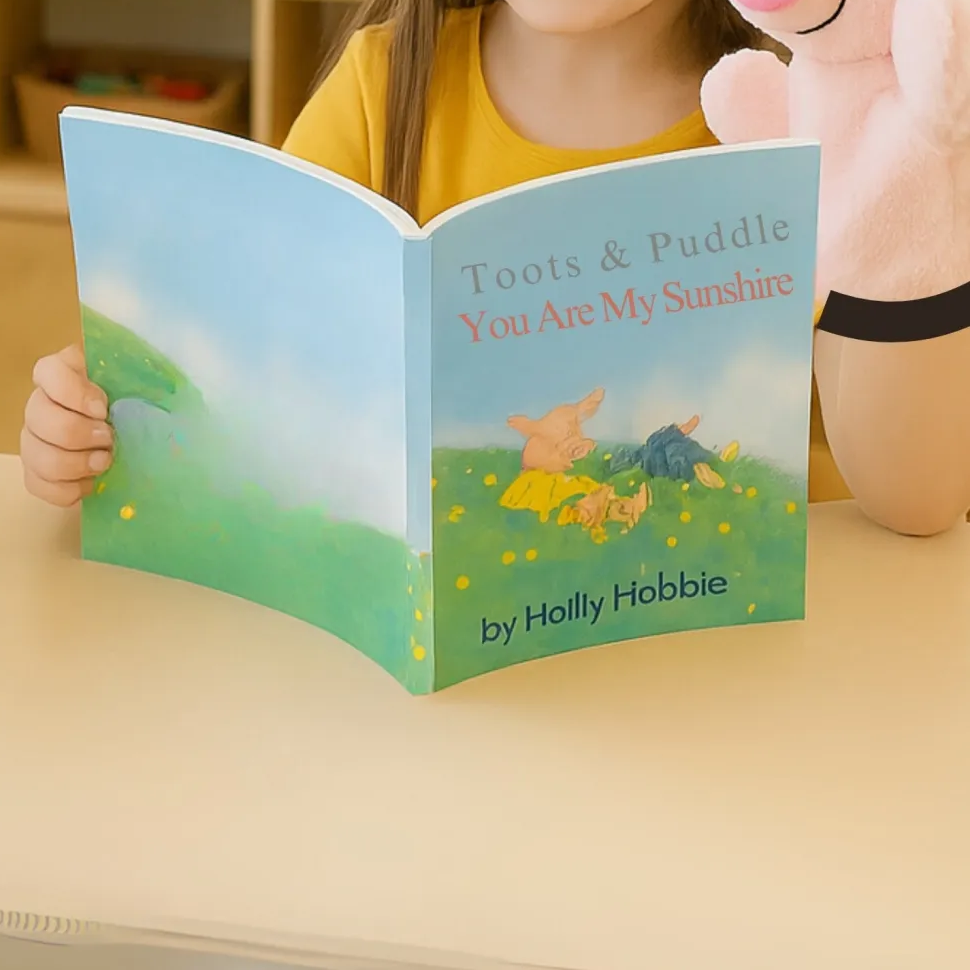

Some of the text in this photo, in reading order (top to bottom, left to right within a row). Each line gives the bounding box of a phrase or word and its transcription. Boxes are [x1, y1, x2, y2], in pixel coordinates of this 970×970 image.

[461, 213, 791, 296] Toots & Puddle
[458, 311, 532, 344] You
[538, 300, 596, 334] Are
[599, 287, 658, 326] My
[481, 617, 517, 646] by
[613, 571, 729, 612] Hobbie
